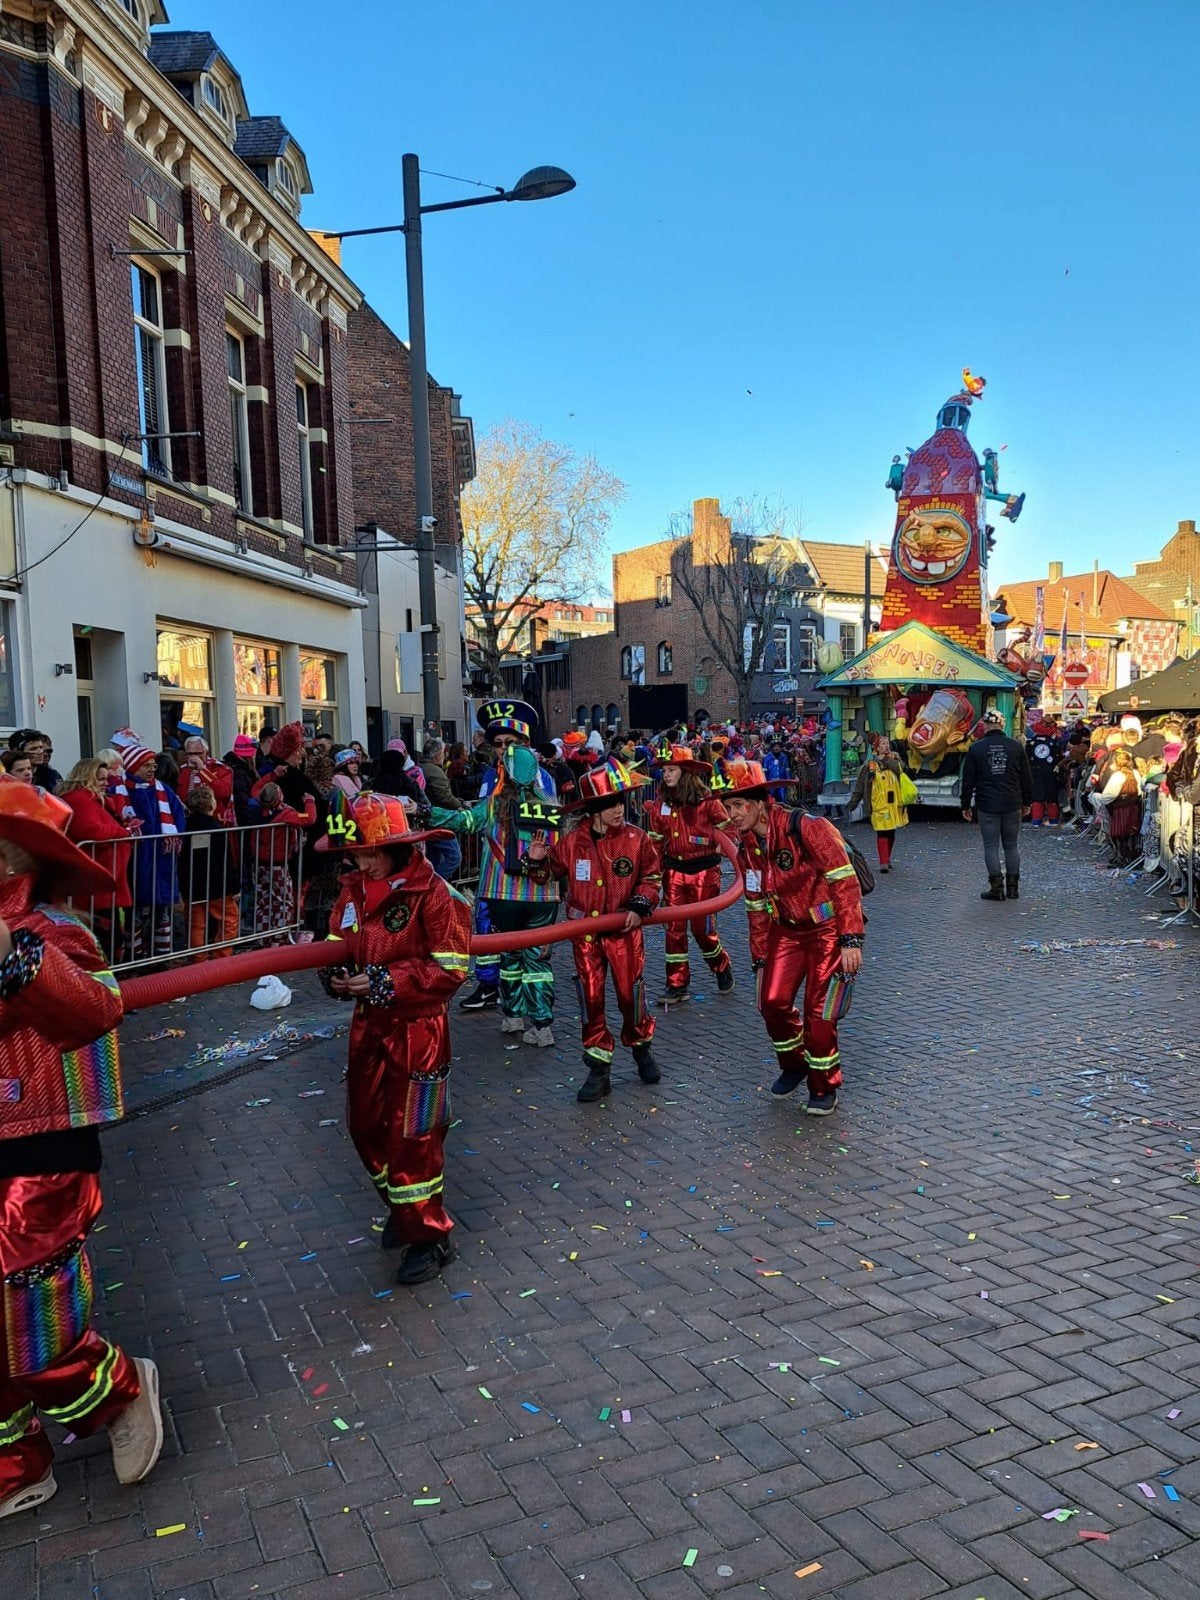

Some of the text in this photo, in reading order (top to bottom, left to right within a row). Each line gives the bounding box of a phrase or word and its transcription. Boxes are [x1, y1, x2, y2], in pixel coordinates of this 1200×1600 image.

[486, 702, 515, 719] 112
[656, 748, 673, 761] 112
[710, 774, 735, 790] 112
[326, 813, 357, 841] 112
